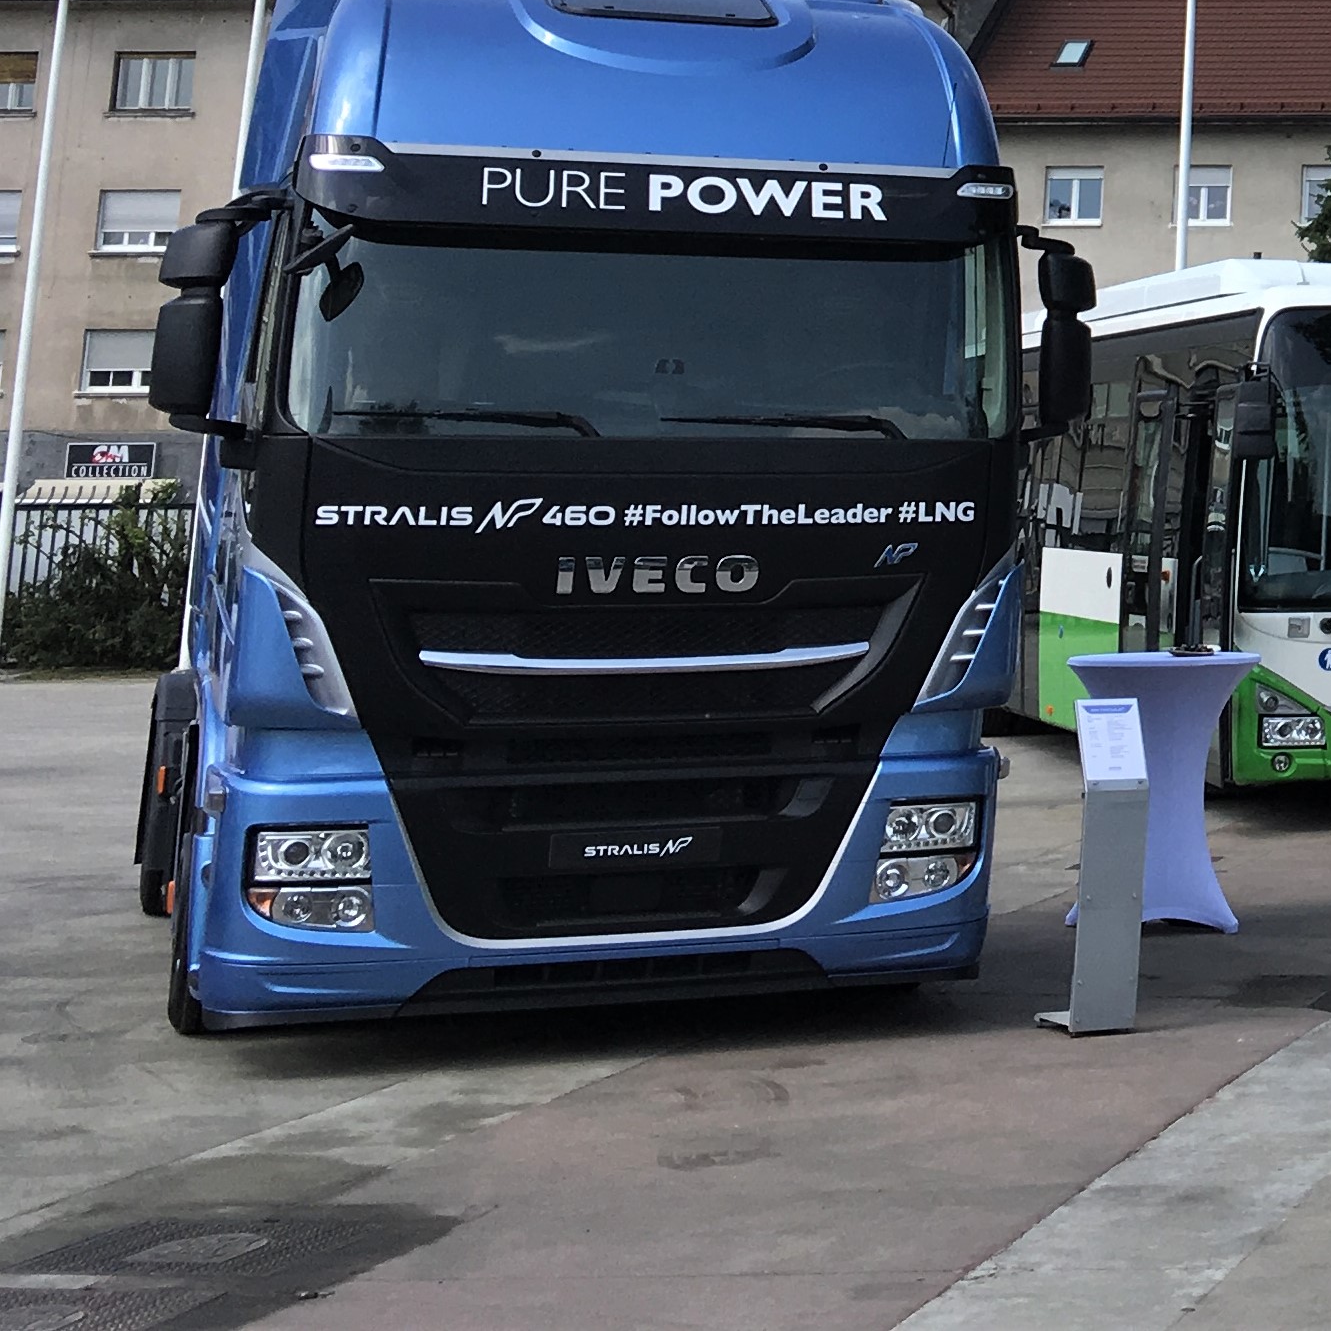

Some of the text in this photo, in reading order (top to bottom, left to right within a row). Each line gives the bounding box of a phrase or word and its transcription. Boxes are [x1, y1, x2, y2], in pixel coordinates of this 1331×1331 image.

[481, 167, 887, 221] PURE POWER
[71, 465, 147, 477] COLLECTION
[315, 505, 473, 526] STRALIS
[542, 505, 615, 526] 460
[624, 504, 893, 527] #FollowTheLeader
[899, 501, 975, 523] #LNG
[556, 554, 759, 594] IVECO
[584, 843, 660, 857] STRALIS
